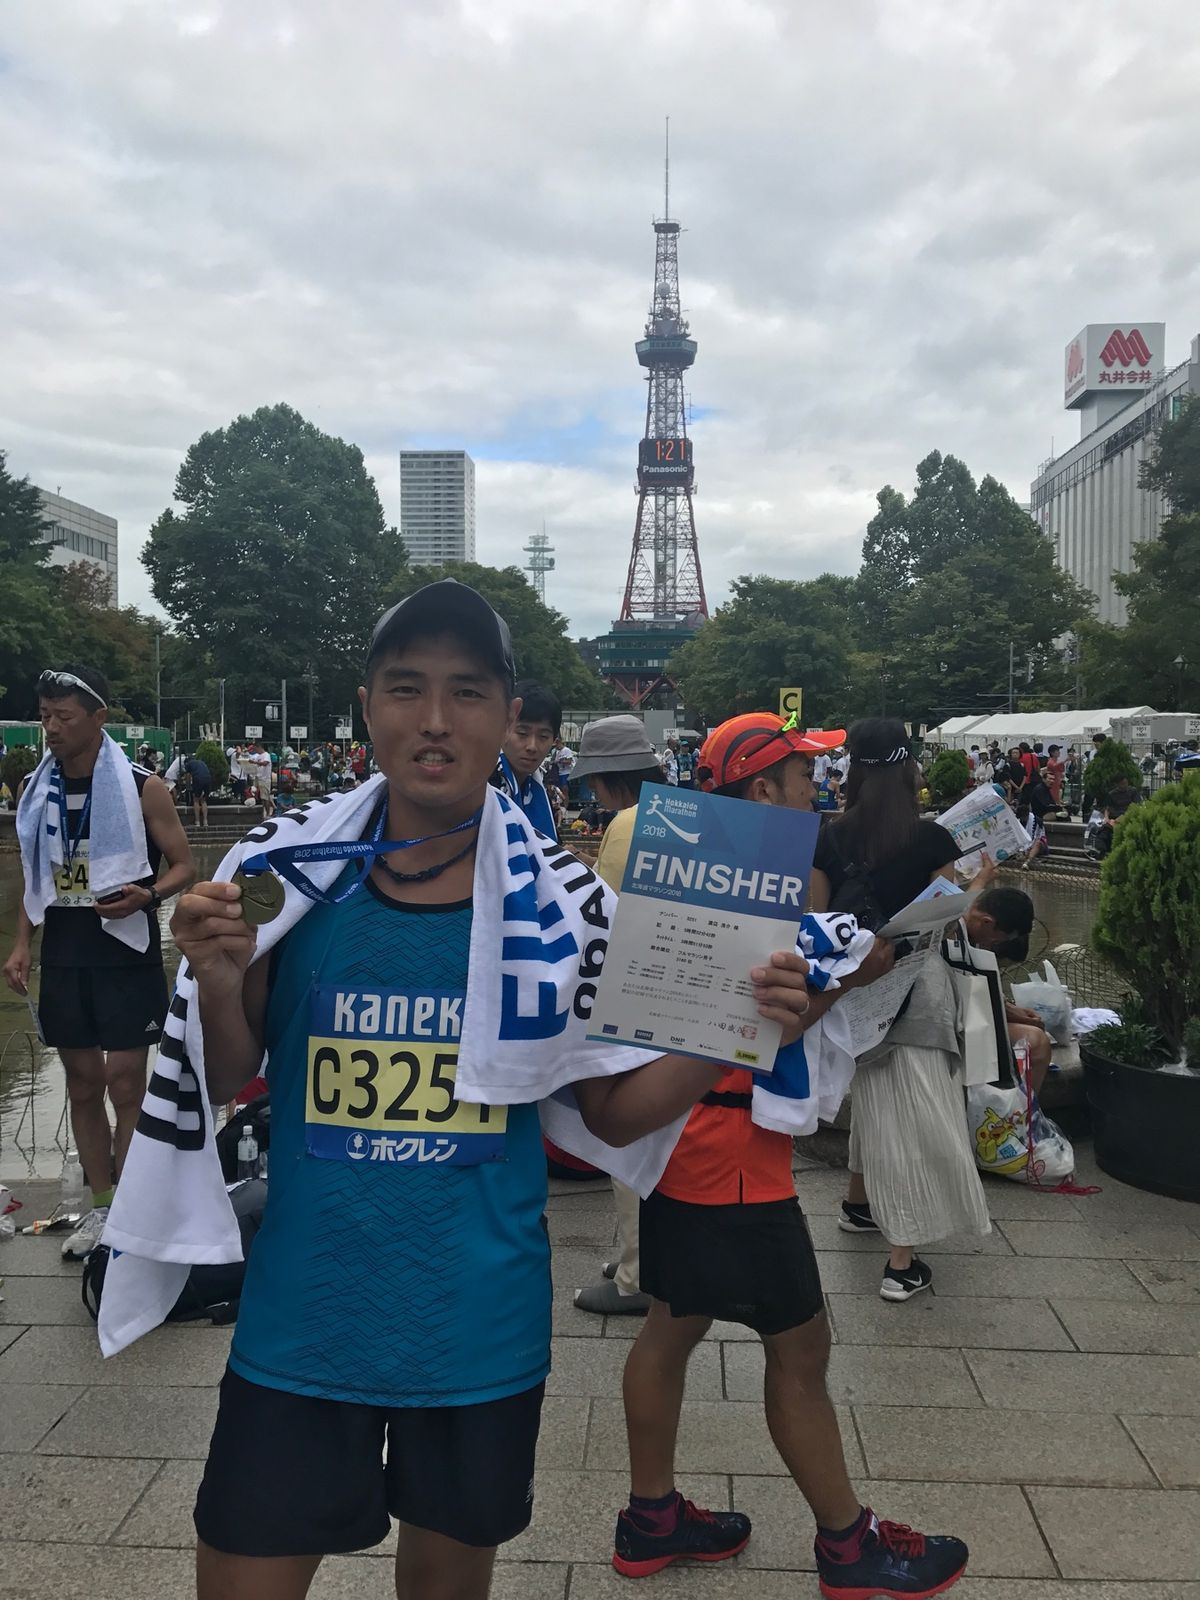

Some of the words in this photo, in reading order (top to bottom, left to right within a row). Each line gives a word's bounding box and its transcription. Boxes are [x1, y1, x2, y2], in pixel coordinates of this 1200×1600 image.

[1098, 370, 1152, 384] 丸井今井
[655, 440, 686, 461] 1:21
[642, 465, 688, 473] Panasonic
[782, 692, 798, 712] C
[663, 805, 697, 818] Marathon
[665, 798, 698, 811] Hokkaido
[642, 824, 667, 839] 2018
[632, 850, 803, 907] FINISHER
[631, 881, 682, 898] 北海道マラソン2018
[313, 1046, 490, 1124] C325
[369, 1136, 458, 1162] ホクレン
